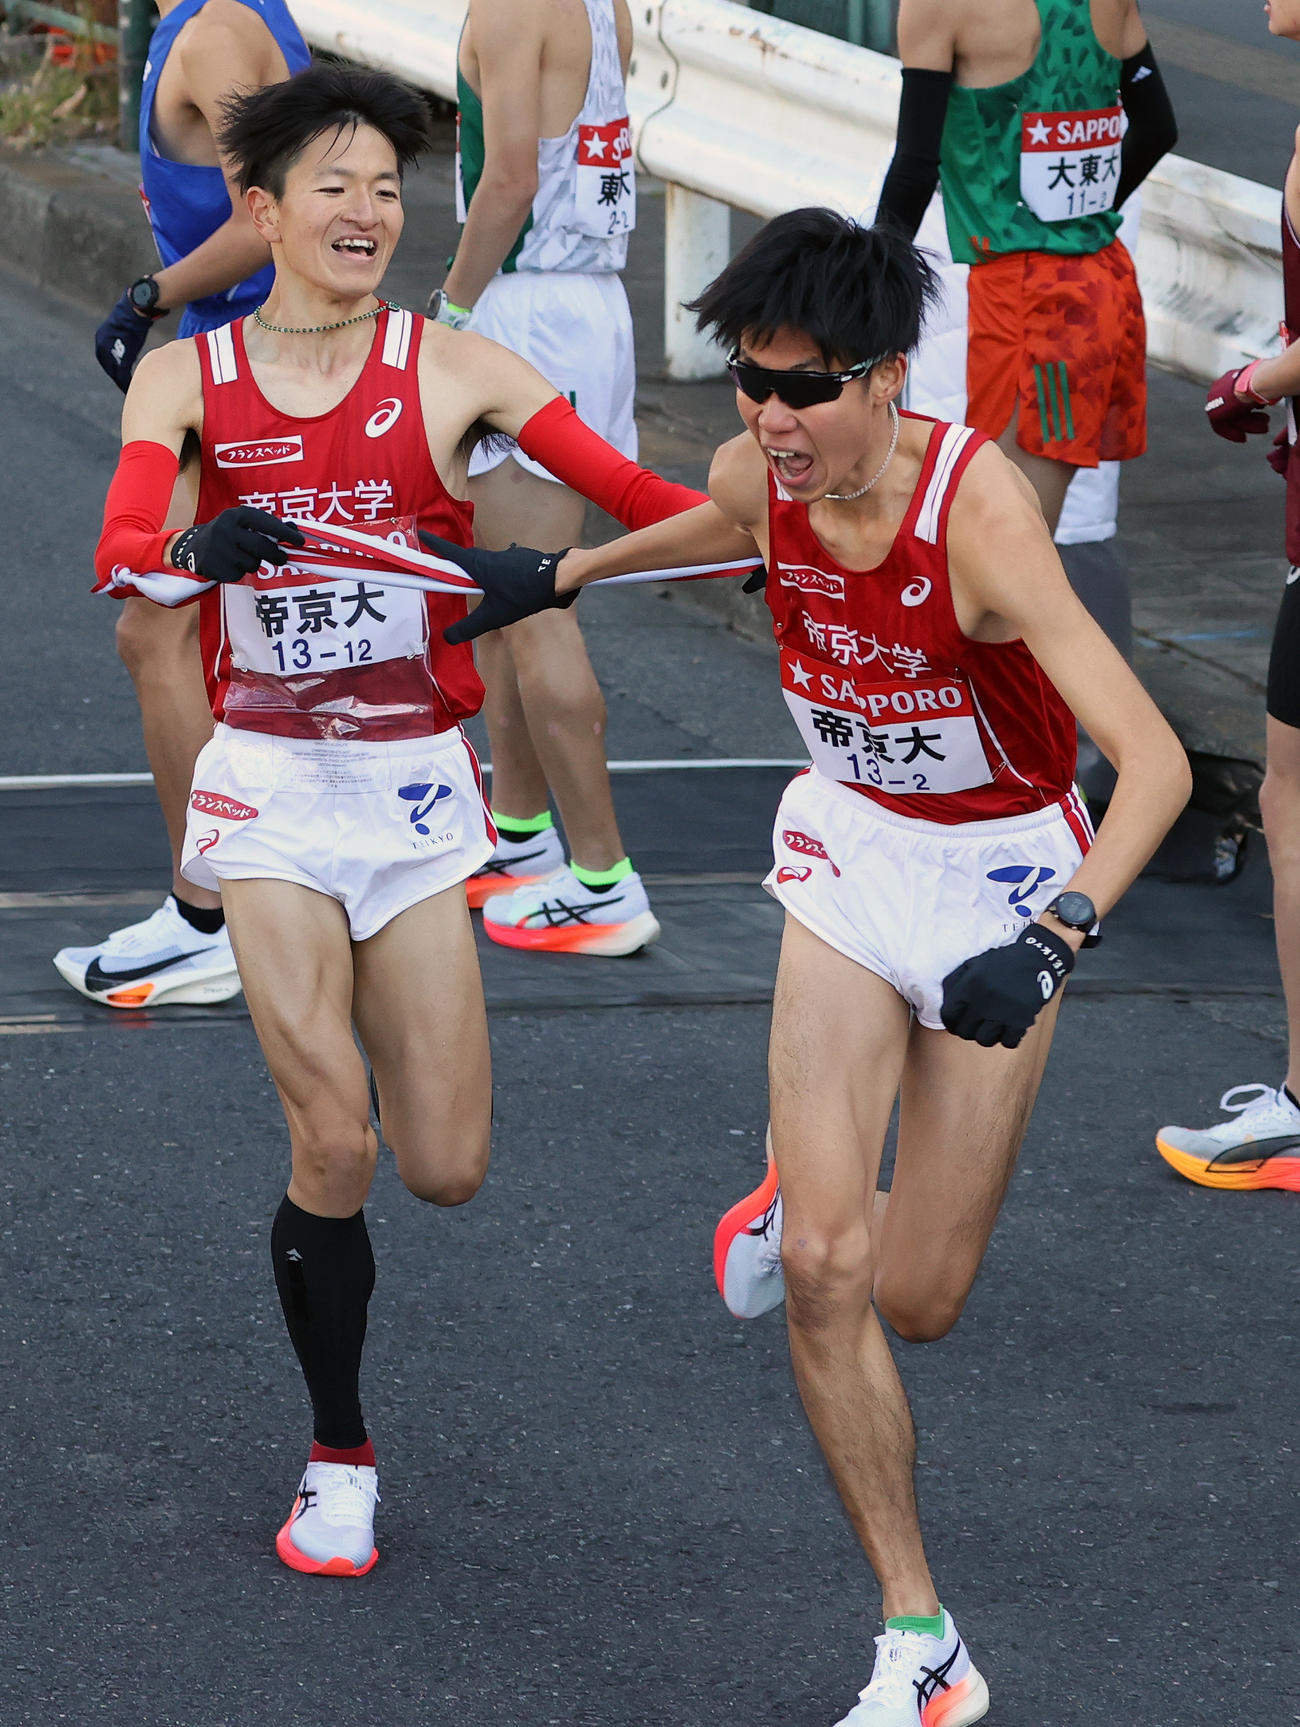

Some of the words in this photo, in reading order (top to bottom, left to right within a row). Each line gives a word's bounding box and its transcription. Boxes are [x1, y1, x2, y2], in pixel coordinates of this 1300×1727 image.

[1047, 147, 1119, 190] 大東大
[227, 445, 291, 460] フランスベッド
[255, 582, 387, 638] 帝京大
[272, 638, 373, 672] 13-12
[810, 708, 947, 765] 帝京大
[847, 753, 930, 792] 13-2
